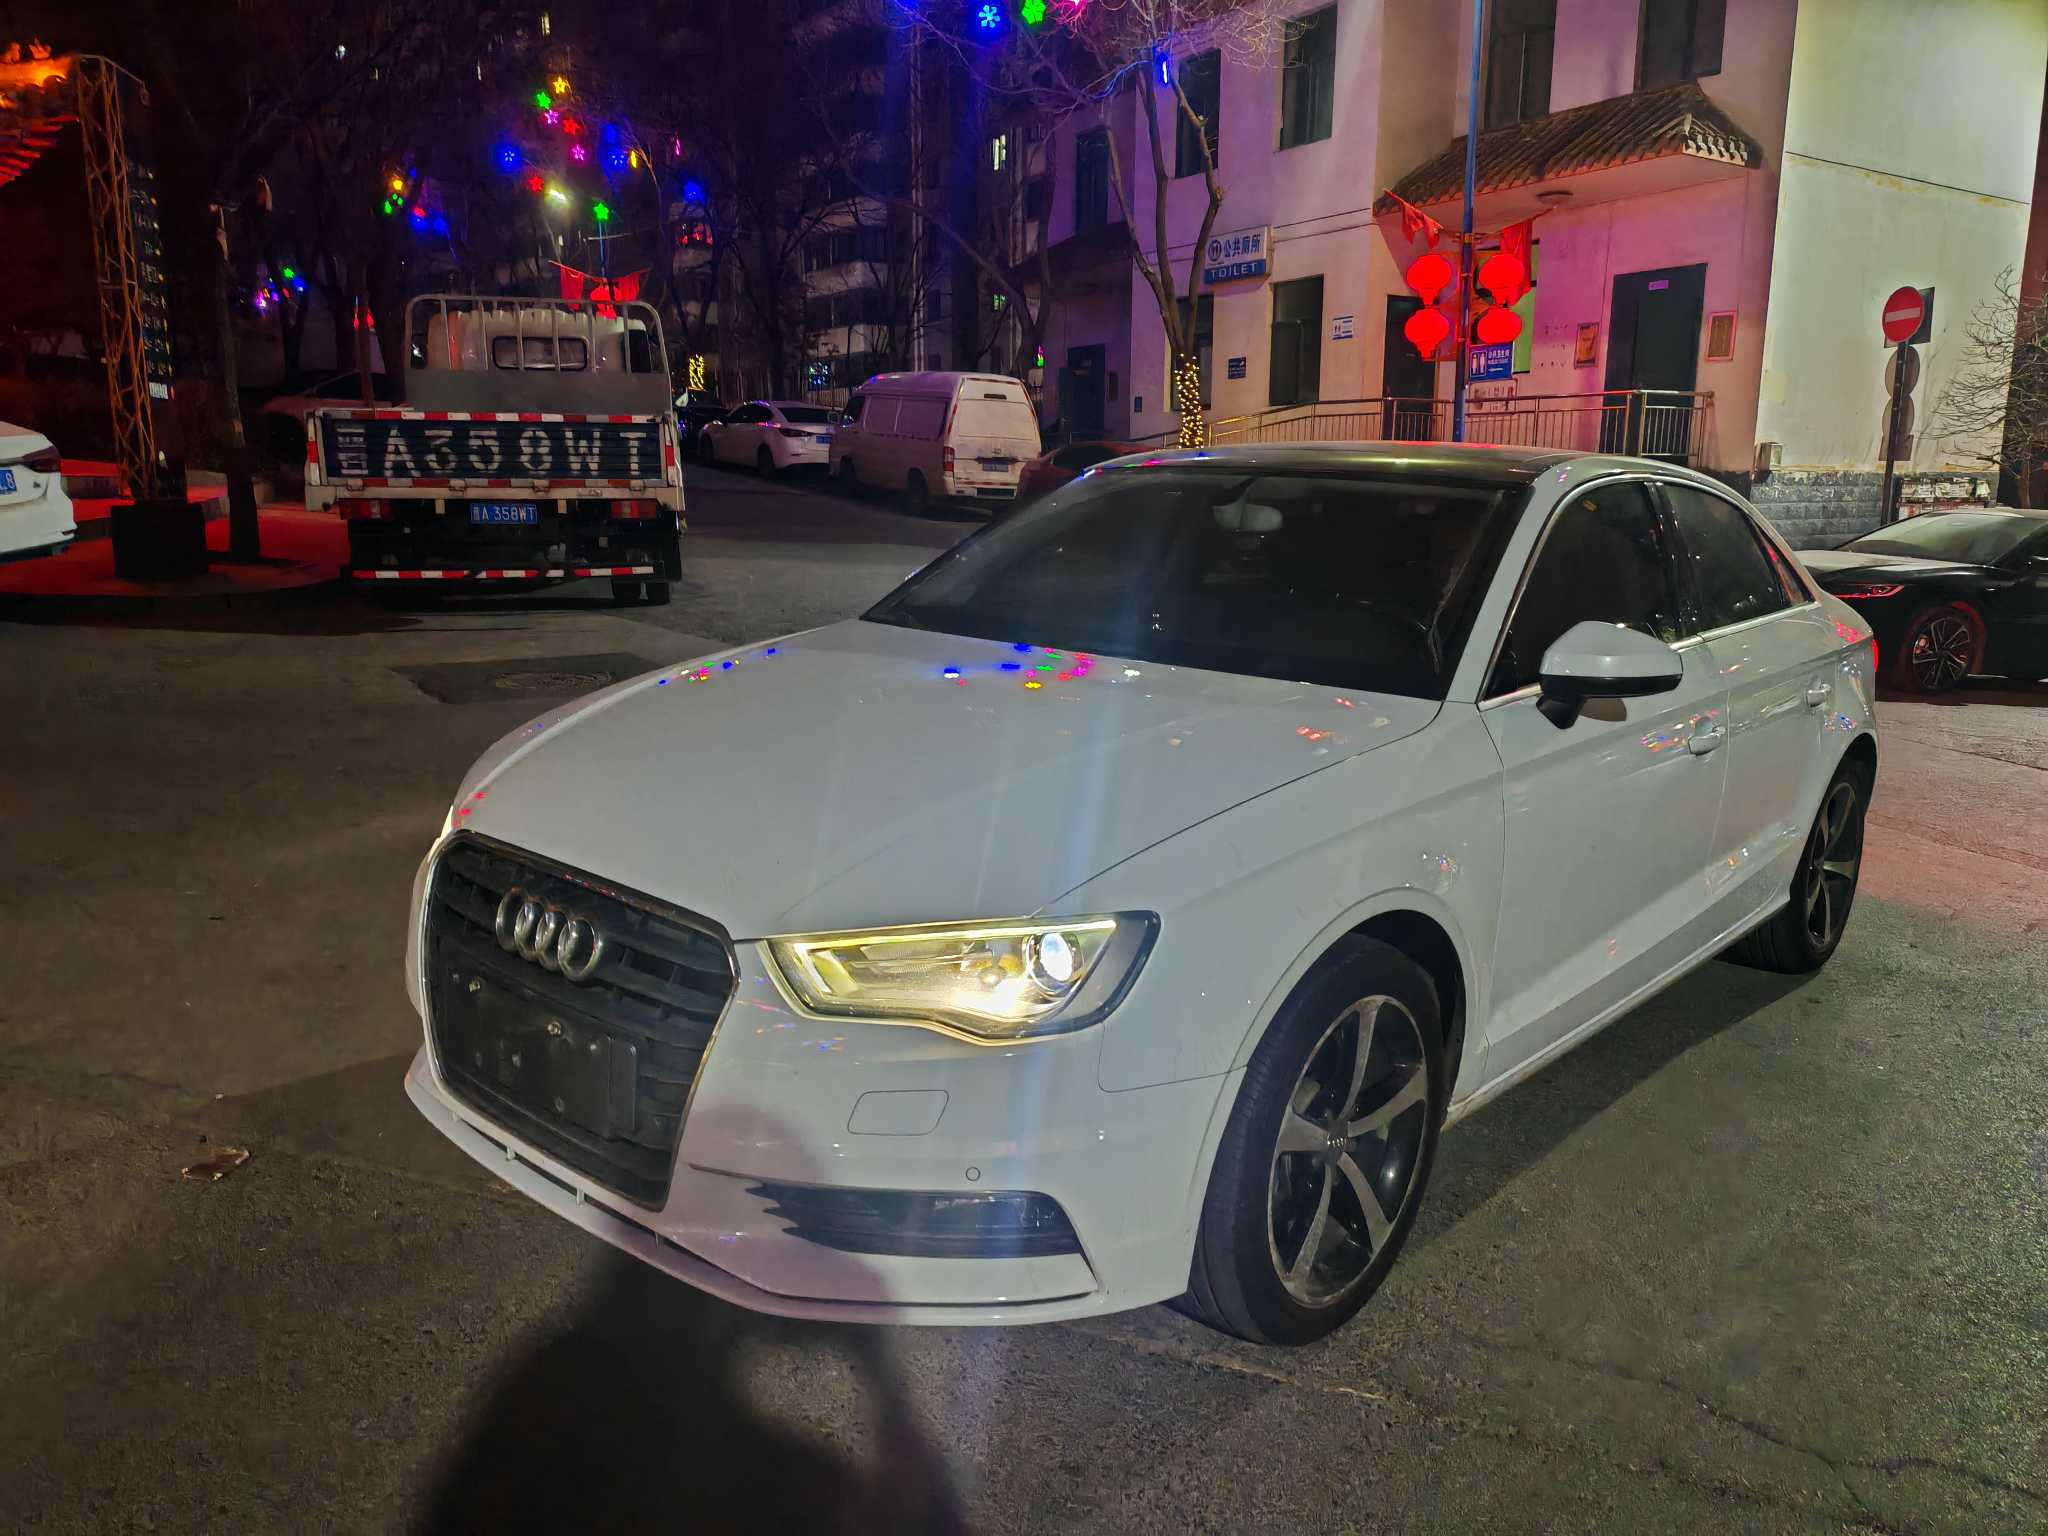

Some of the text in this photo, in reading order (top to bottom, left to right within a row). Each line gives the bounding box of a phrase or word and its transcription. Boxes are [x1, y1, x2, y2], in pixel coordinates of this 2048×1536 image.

[1223, 233, 1261, 258] 公共厕所
[1210, 263, 1258, 281] TOILET
